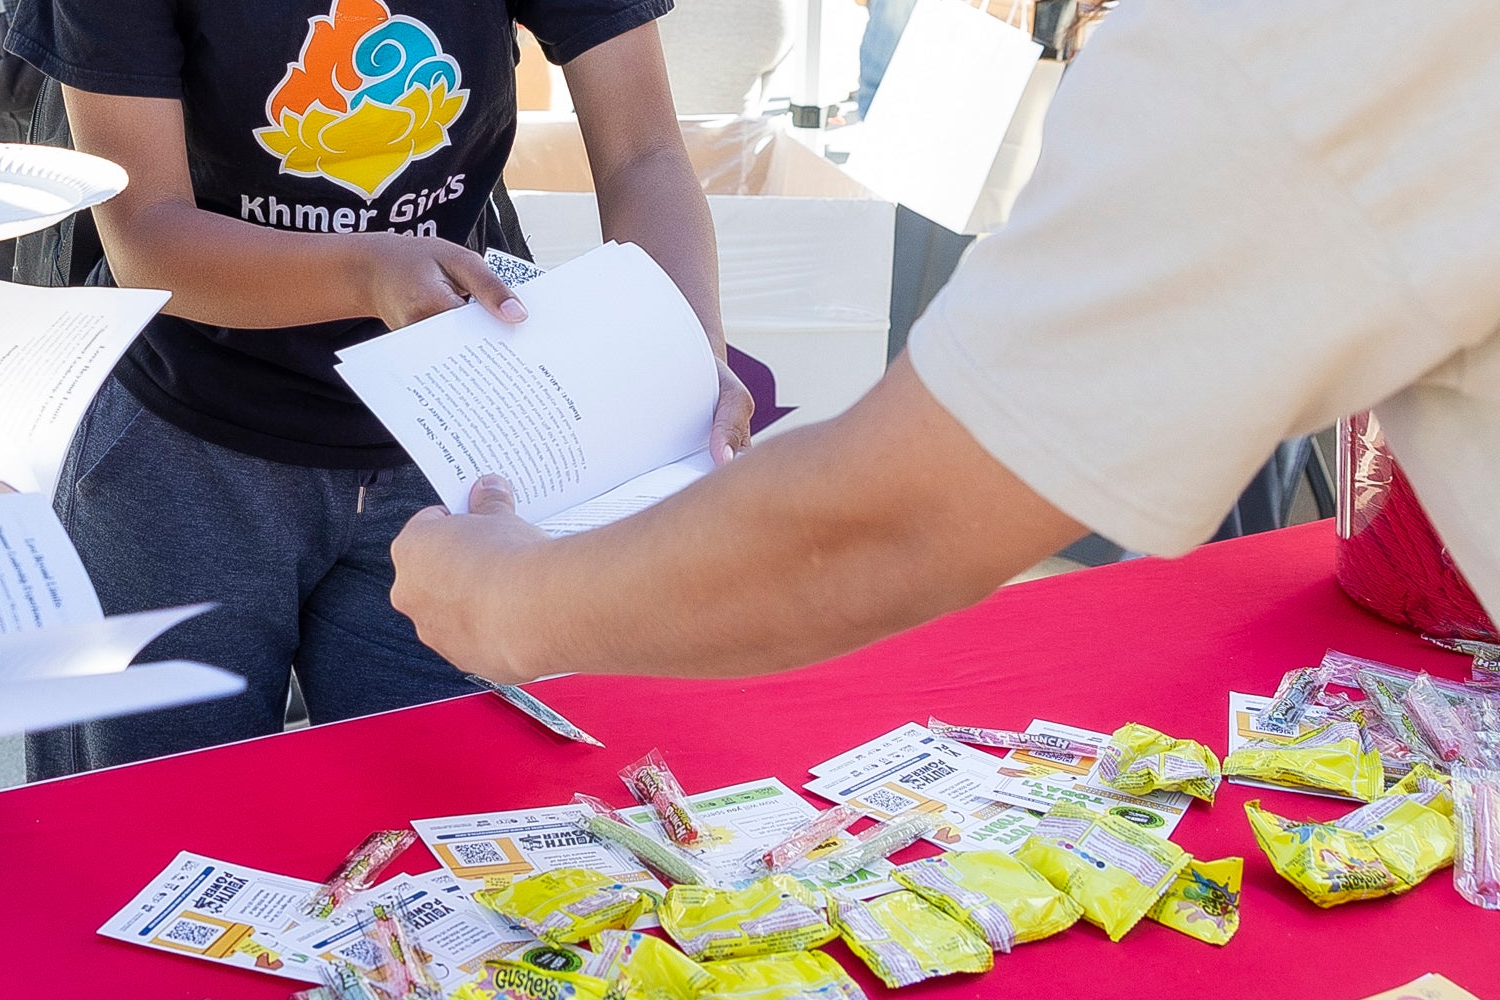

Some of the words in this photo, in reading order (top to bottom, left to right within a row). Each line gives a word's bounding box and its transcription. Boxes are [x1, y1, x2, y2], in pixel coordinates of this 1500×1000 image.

[241, 194, 378, 234] Khmer
[446, 355, 458, 365] and
[495, 351, 507, 361] and
[441, 362, 450, 370] are
[473, 367, 483, 377] can
[412, 374, 426, 386] your
[422, 385, 435, 398] what
[444, 392, 459, 408] media
[433, 396, 455, 419] knowing
[560, 391, 581, 421] Budget:
[416, 417, 437, 440] Sheep
[427, 407, 450, 431] Master
[524, 414, 535, 426] and
[561, 418, 572, 430] and
[453, 464, 466, 480] The
[502, 451, 519, 475] working
[510, 476, 535, 504] everyone
[1019, 733, 1071, 750] PUNCH
[910, 759, 945, 776] POWER
[919, 765, 958, 784] YOUTH
[639, 769, 659, 799] PUNCH
[1021, 780, 1105, 805] TODAY!
[726, 805, 741, 813] you
[665, 805, 688, 842] PUNCH
[972, 813, 1026, 842] TODAY!
[544, 833, 600, 848] YOUTH
[200, 871, 233, 898] POWER
[216, 876, 248, 903] YOUTH
[411, 904, 455, 930] YOUTH
